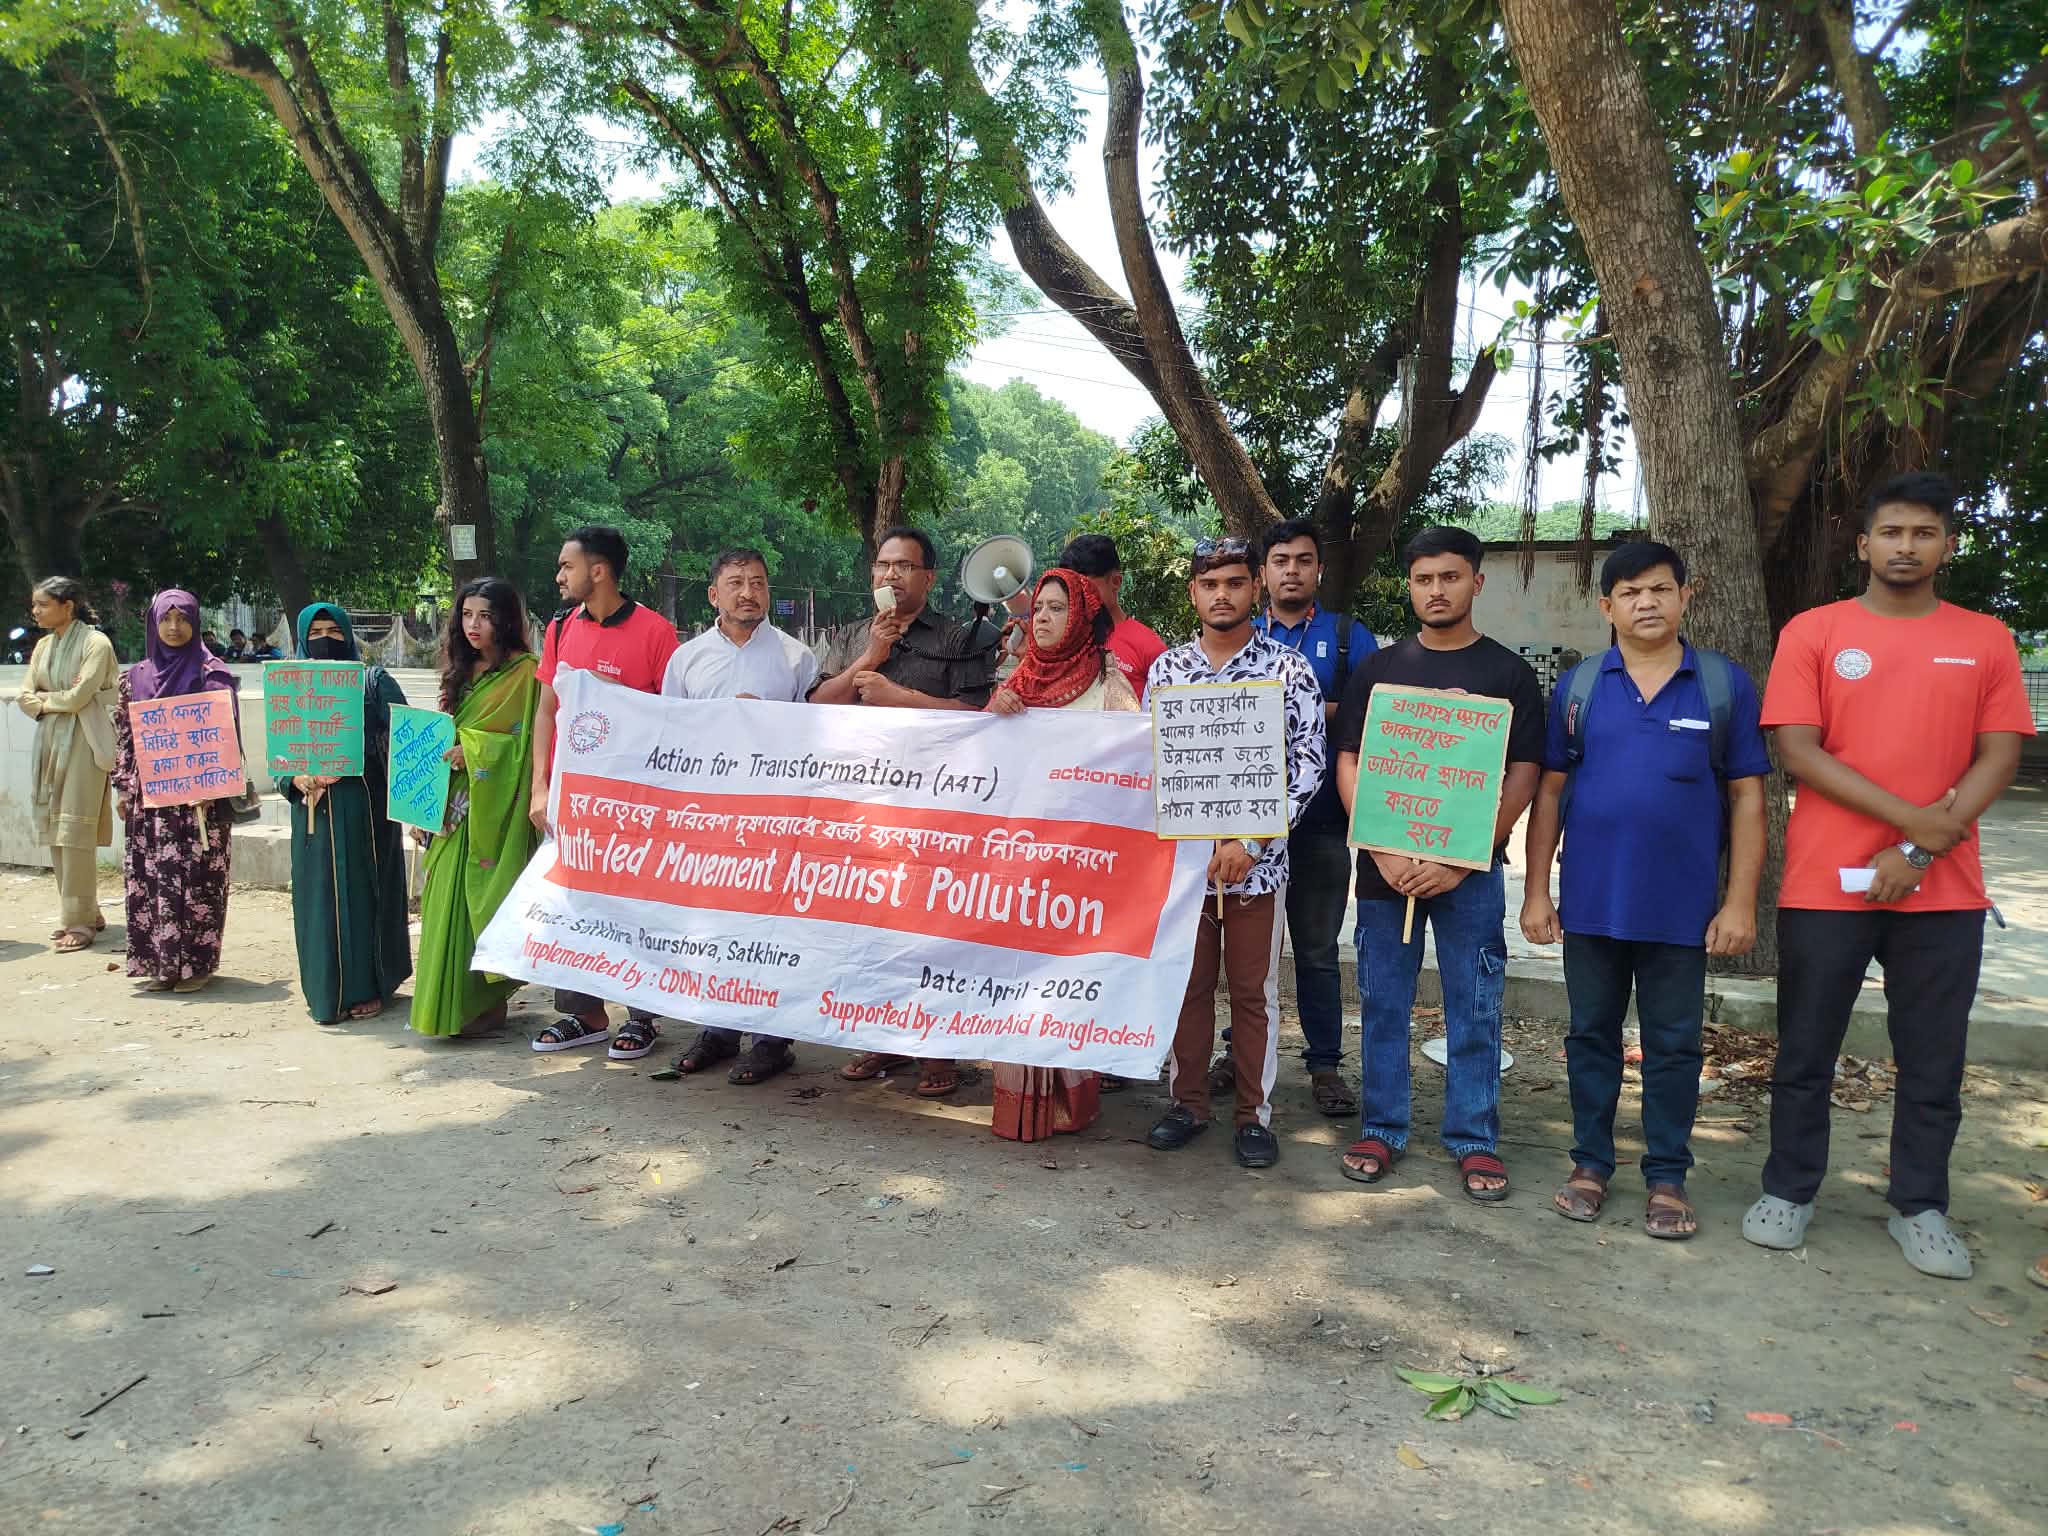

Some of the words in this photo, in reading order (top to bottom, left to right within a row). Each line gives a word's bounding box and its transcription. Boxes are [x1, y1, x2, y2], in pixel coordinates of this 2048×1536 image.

[138, 704, 167, 725] বর্জ্য
[171, 701, 214, 724] ফেলুন
[1160, 700, 1183, 719] যুব
[1160, 725, 1194, 739] খালের
[1200, 716, 1246, 740] পরিচর্যা
[1254, 721, 1265, 734] ও
[150, 757, 183, 775] রক্ষা
[184, 752, 219, 768] করুন
[1163, 742, 1224, 764] উন্নয়নের
[1233, 746, 1273, 762] জন্য
[146, 776, 192, 795] আমাদের
[194, 766, 240, 788] পরিবেশ
[645, 745, 702, 777] Action
[711, 751, 738, 777] for
[750, 752, 923, 791] Transformation
[933, 764, 999, 802] (A4T)
[1161, 770, 1221, 793] পরিচালনা
[1227, 764, 1278, 790] কমিটি
[1367, 746, 1431, 782] ডাস্টবিন
[1438, 765, 1488, 792] স্থাপন
[1160, 798, 1195, 819] গঠন
[1198, 799, 1242, 819] করতে
[1247, 799, 1279, 819] হবে
[1384, 790, 1443, 817] করতে
[569, 793, 592, 821] যুব
[593, 797, 661, 831] নেতৃত্বে
[665, 802, 734, 833] পরিবেশ
[822, 815, 866, 843] বর্জ্য
[869, 824, 974, 858] ব্যবস্থাপনা
[982, 827, 1118, 874] নিশ্চিতকরণে
[1406, 820, 1453, 849] হবে
[655, 840, 778, 893] Movement
[783, 851, 908, 913] Against
[926, 865, 1104, 936] Pollution
[522, 933, 623, 979] Implemented
[570, 917, 633, 945] Satkhira
[727, 940, 800, 967] Satkhira
[819, 990, 911, 1032] Supported
[946, 1010, 1034, 1036] ActionAid
[1040, 1013, 1155, 1051] Bangladesh
